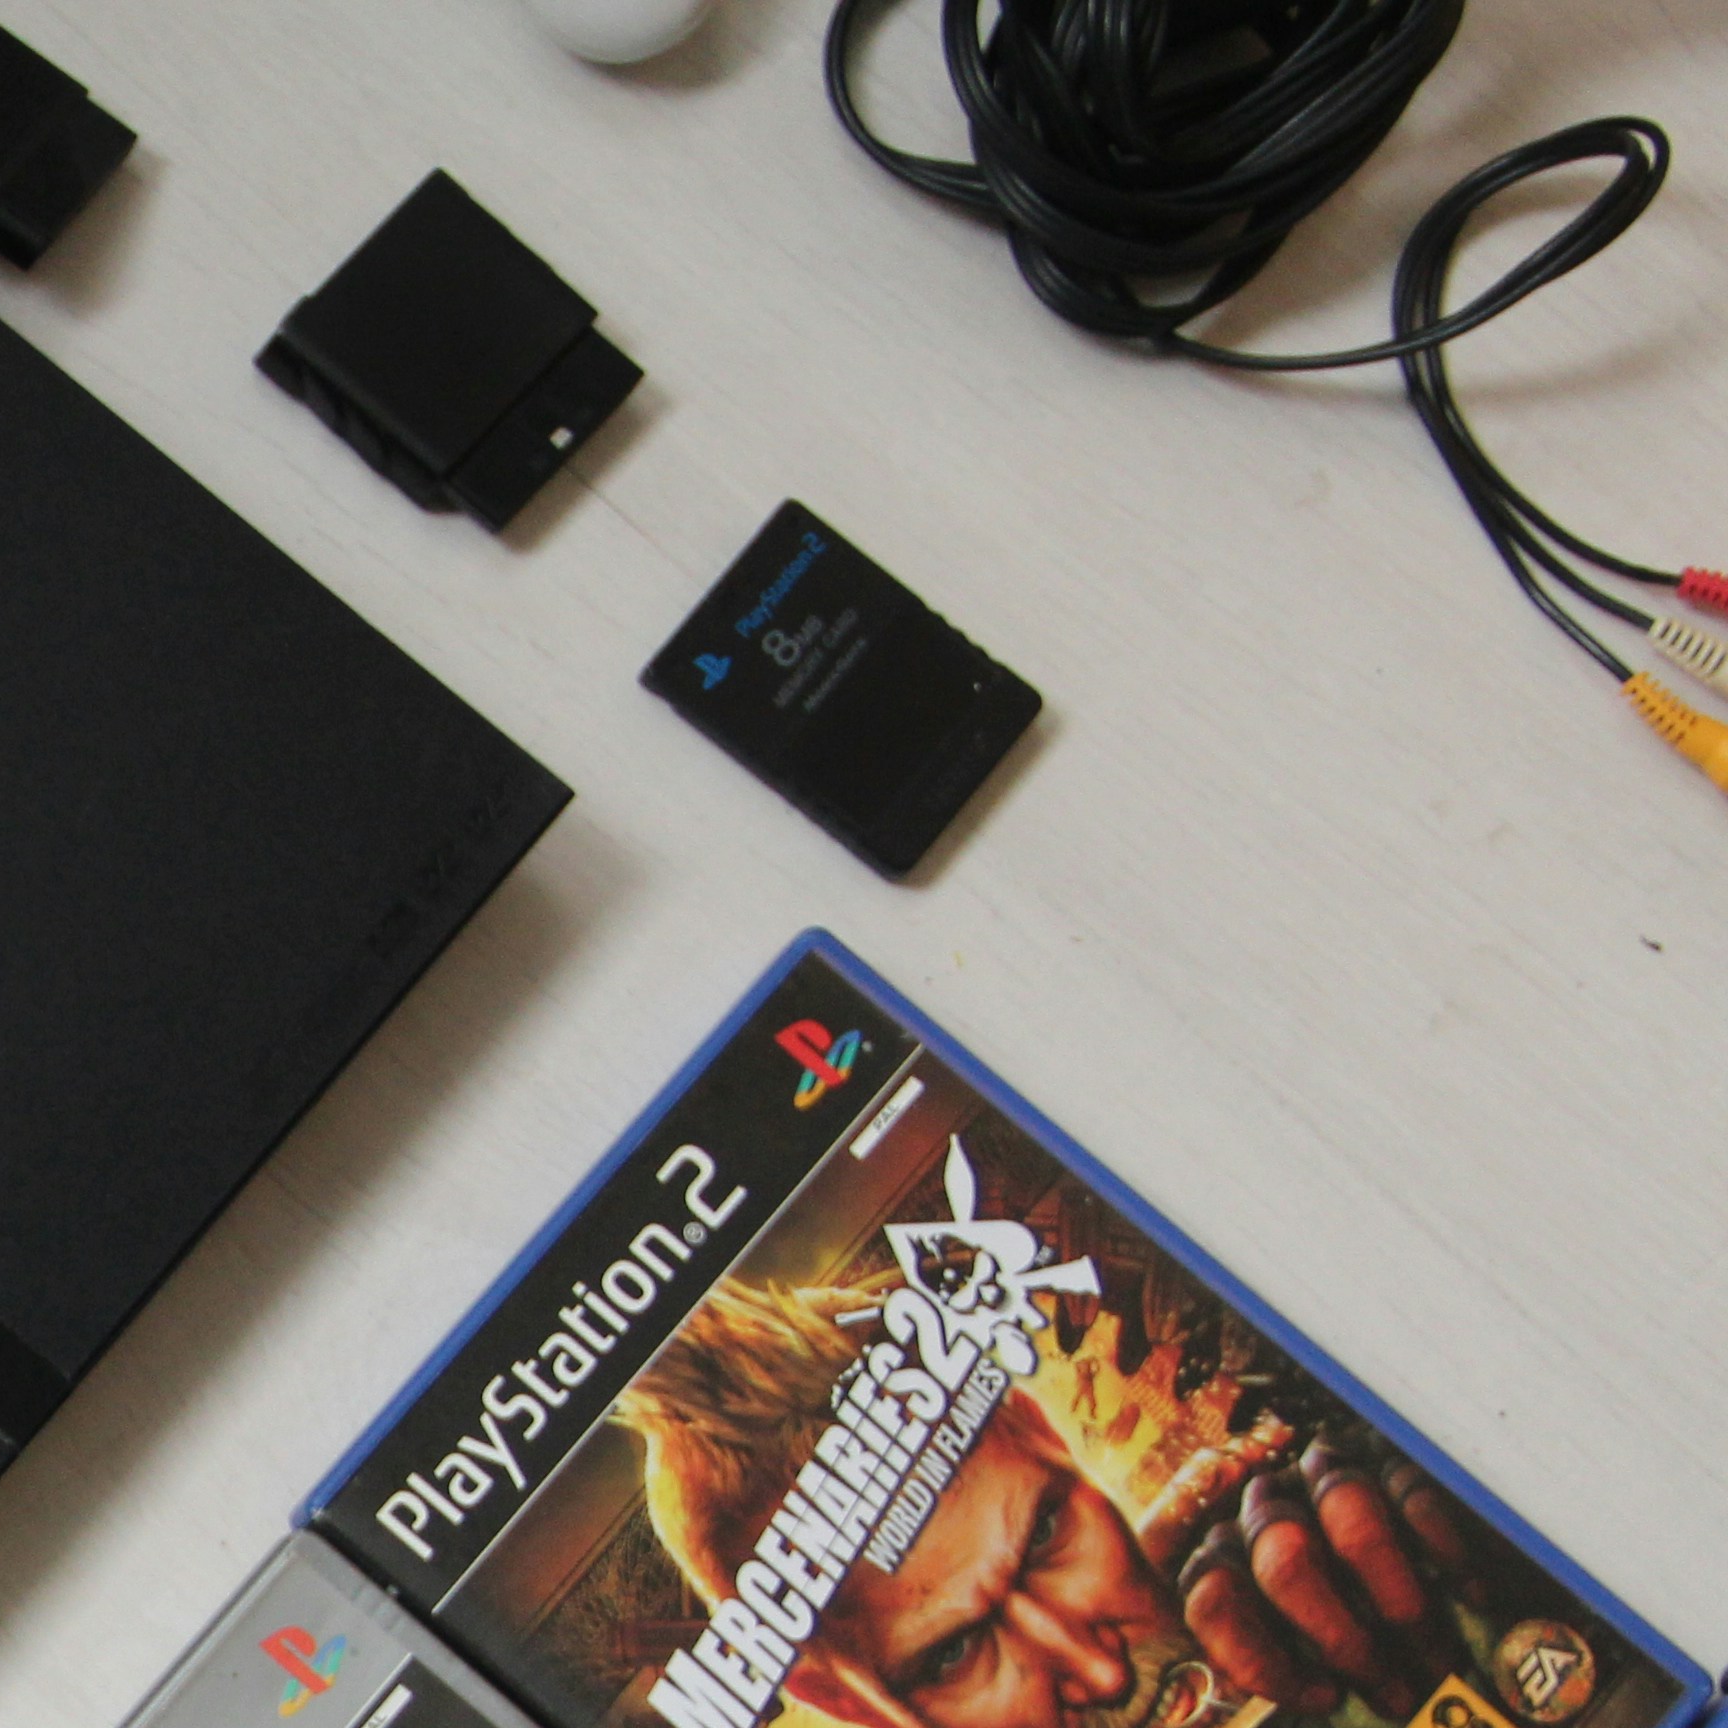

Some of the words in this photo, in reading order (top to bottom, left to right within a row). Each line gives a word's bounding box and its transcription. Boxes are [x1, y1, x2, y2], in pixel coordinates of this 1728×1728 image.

[932, 1356, 1012, 1463] FLAMES
[914, 1447, 956, 1491] IN
[865, 1479, 938, 1575] WORLD
[1515, 1646, 1583, 1707] EA
